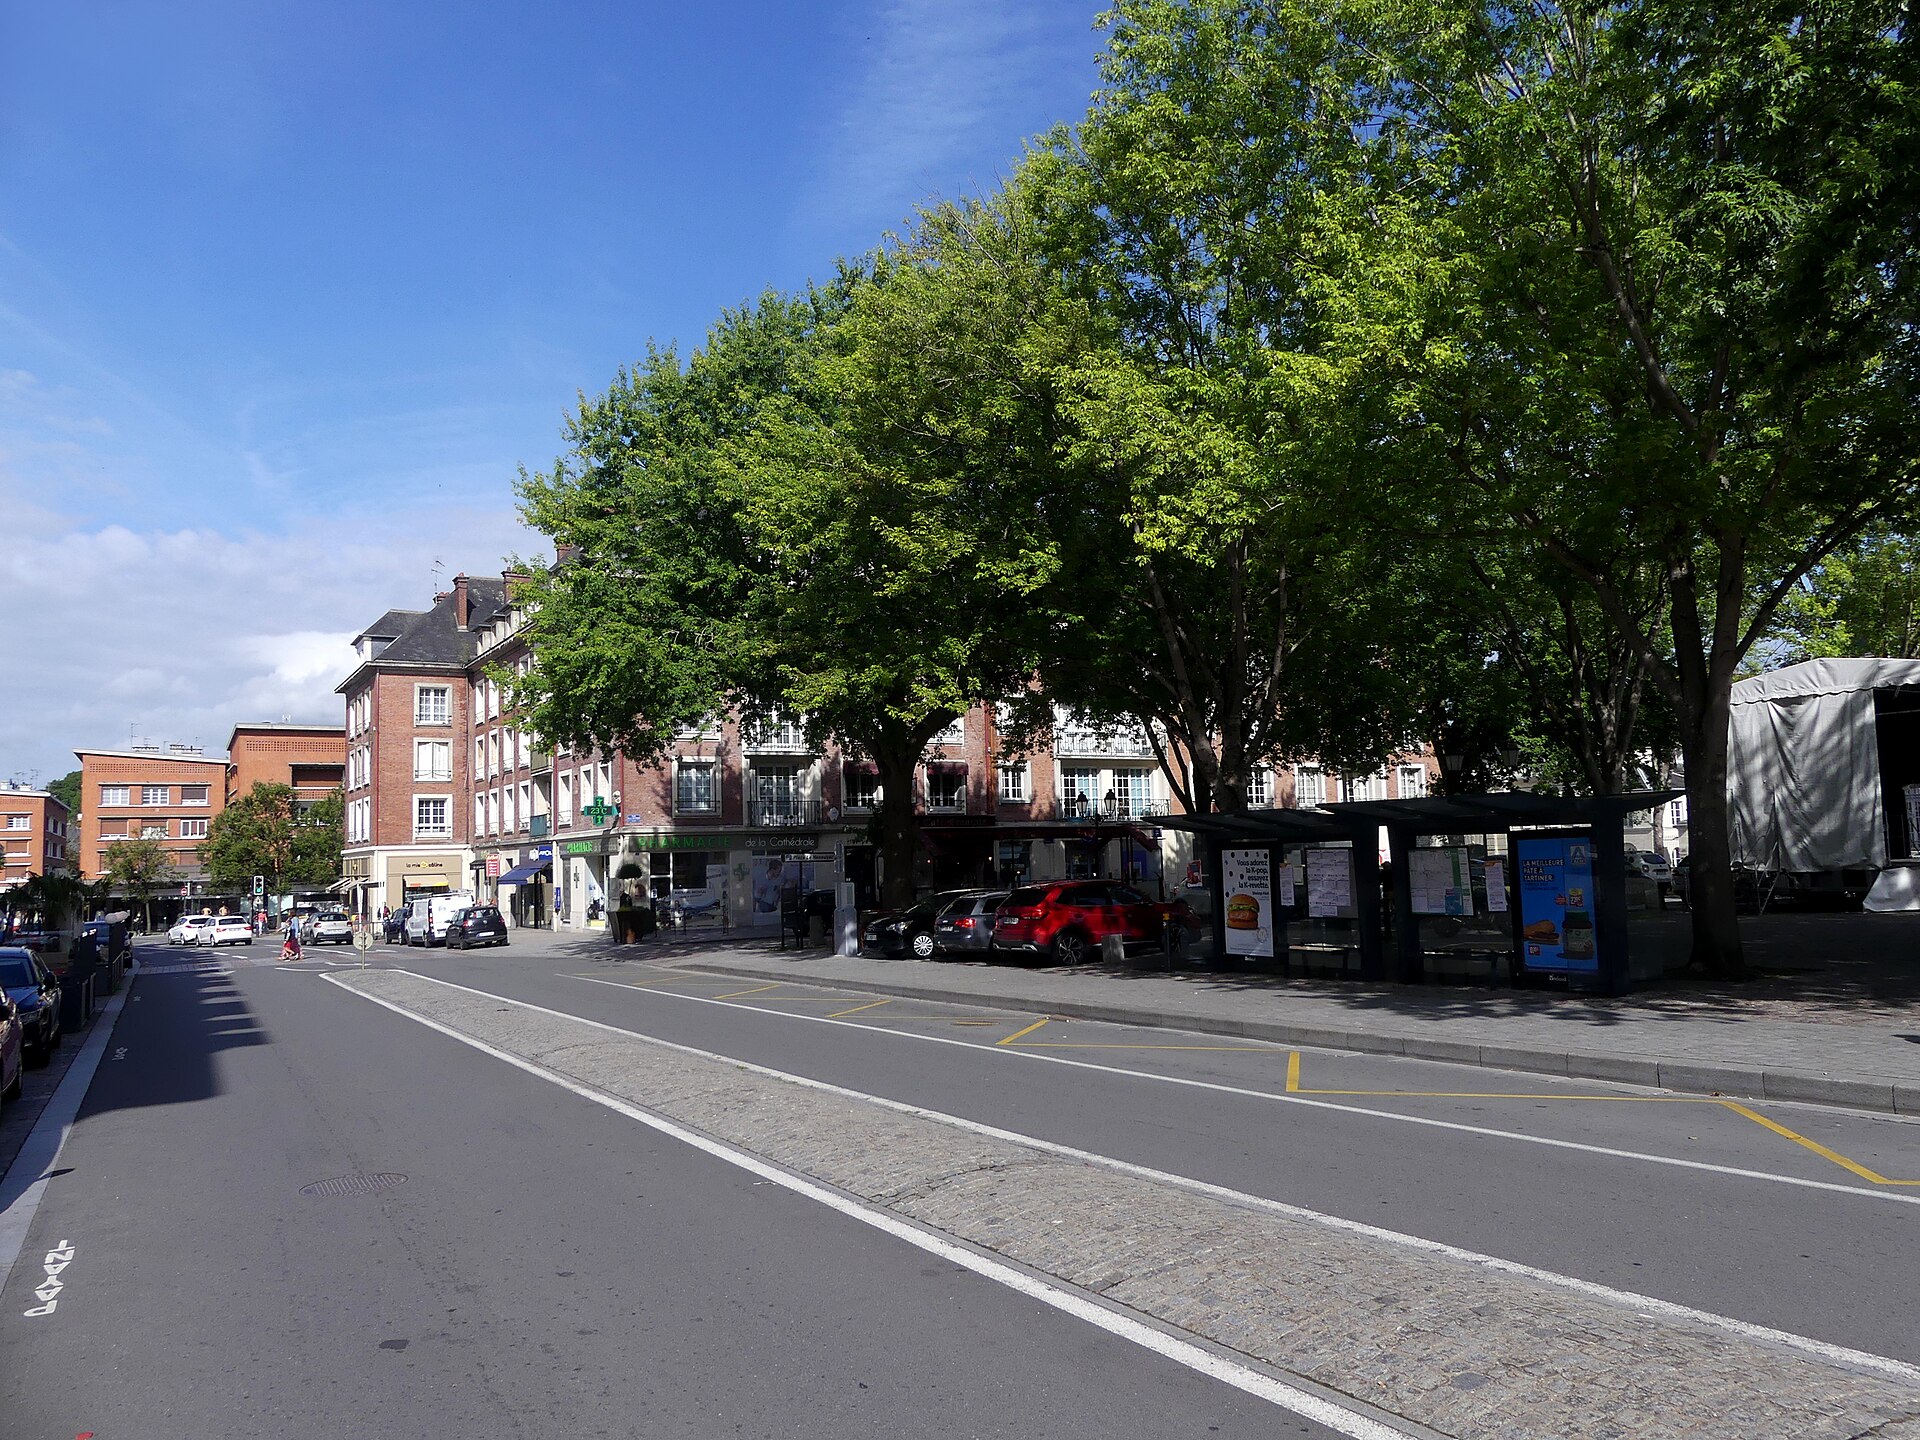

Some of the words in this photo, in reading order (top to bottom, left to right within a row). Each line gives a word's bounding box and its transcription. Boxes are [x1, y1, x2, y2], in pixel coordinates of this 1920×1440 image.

[637, 836, 730, 848] PHARMACIE
[745, 838, 756, 847] de
[758, 838, 767, 847] la
[769, 836, 816, 847] Cathédrale
[1531, 859, 1564, 867] MEILLEURE
[1248, 875, 1268, 883] essayez
[24, 1239, 76, 1317] PAYANT
